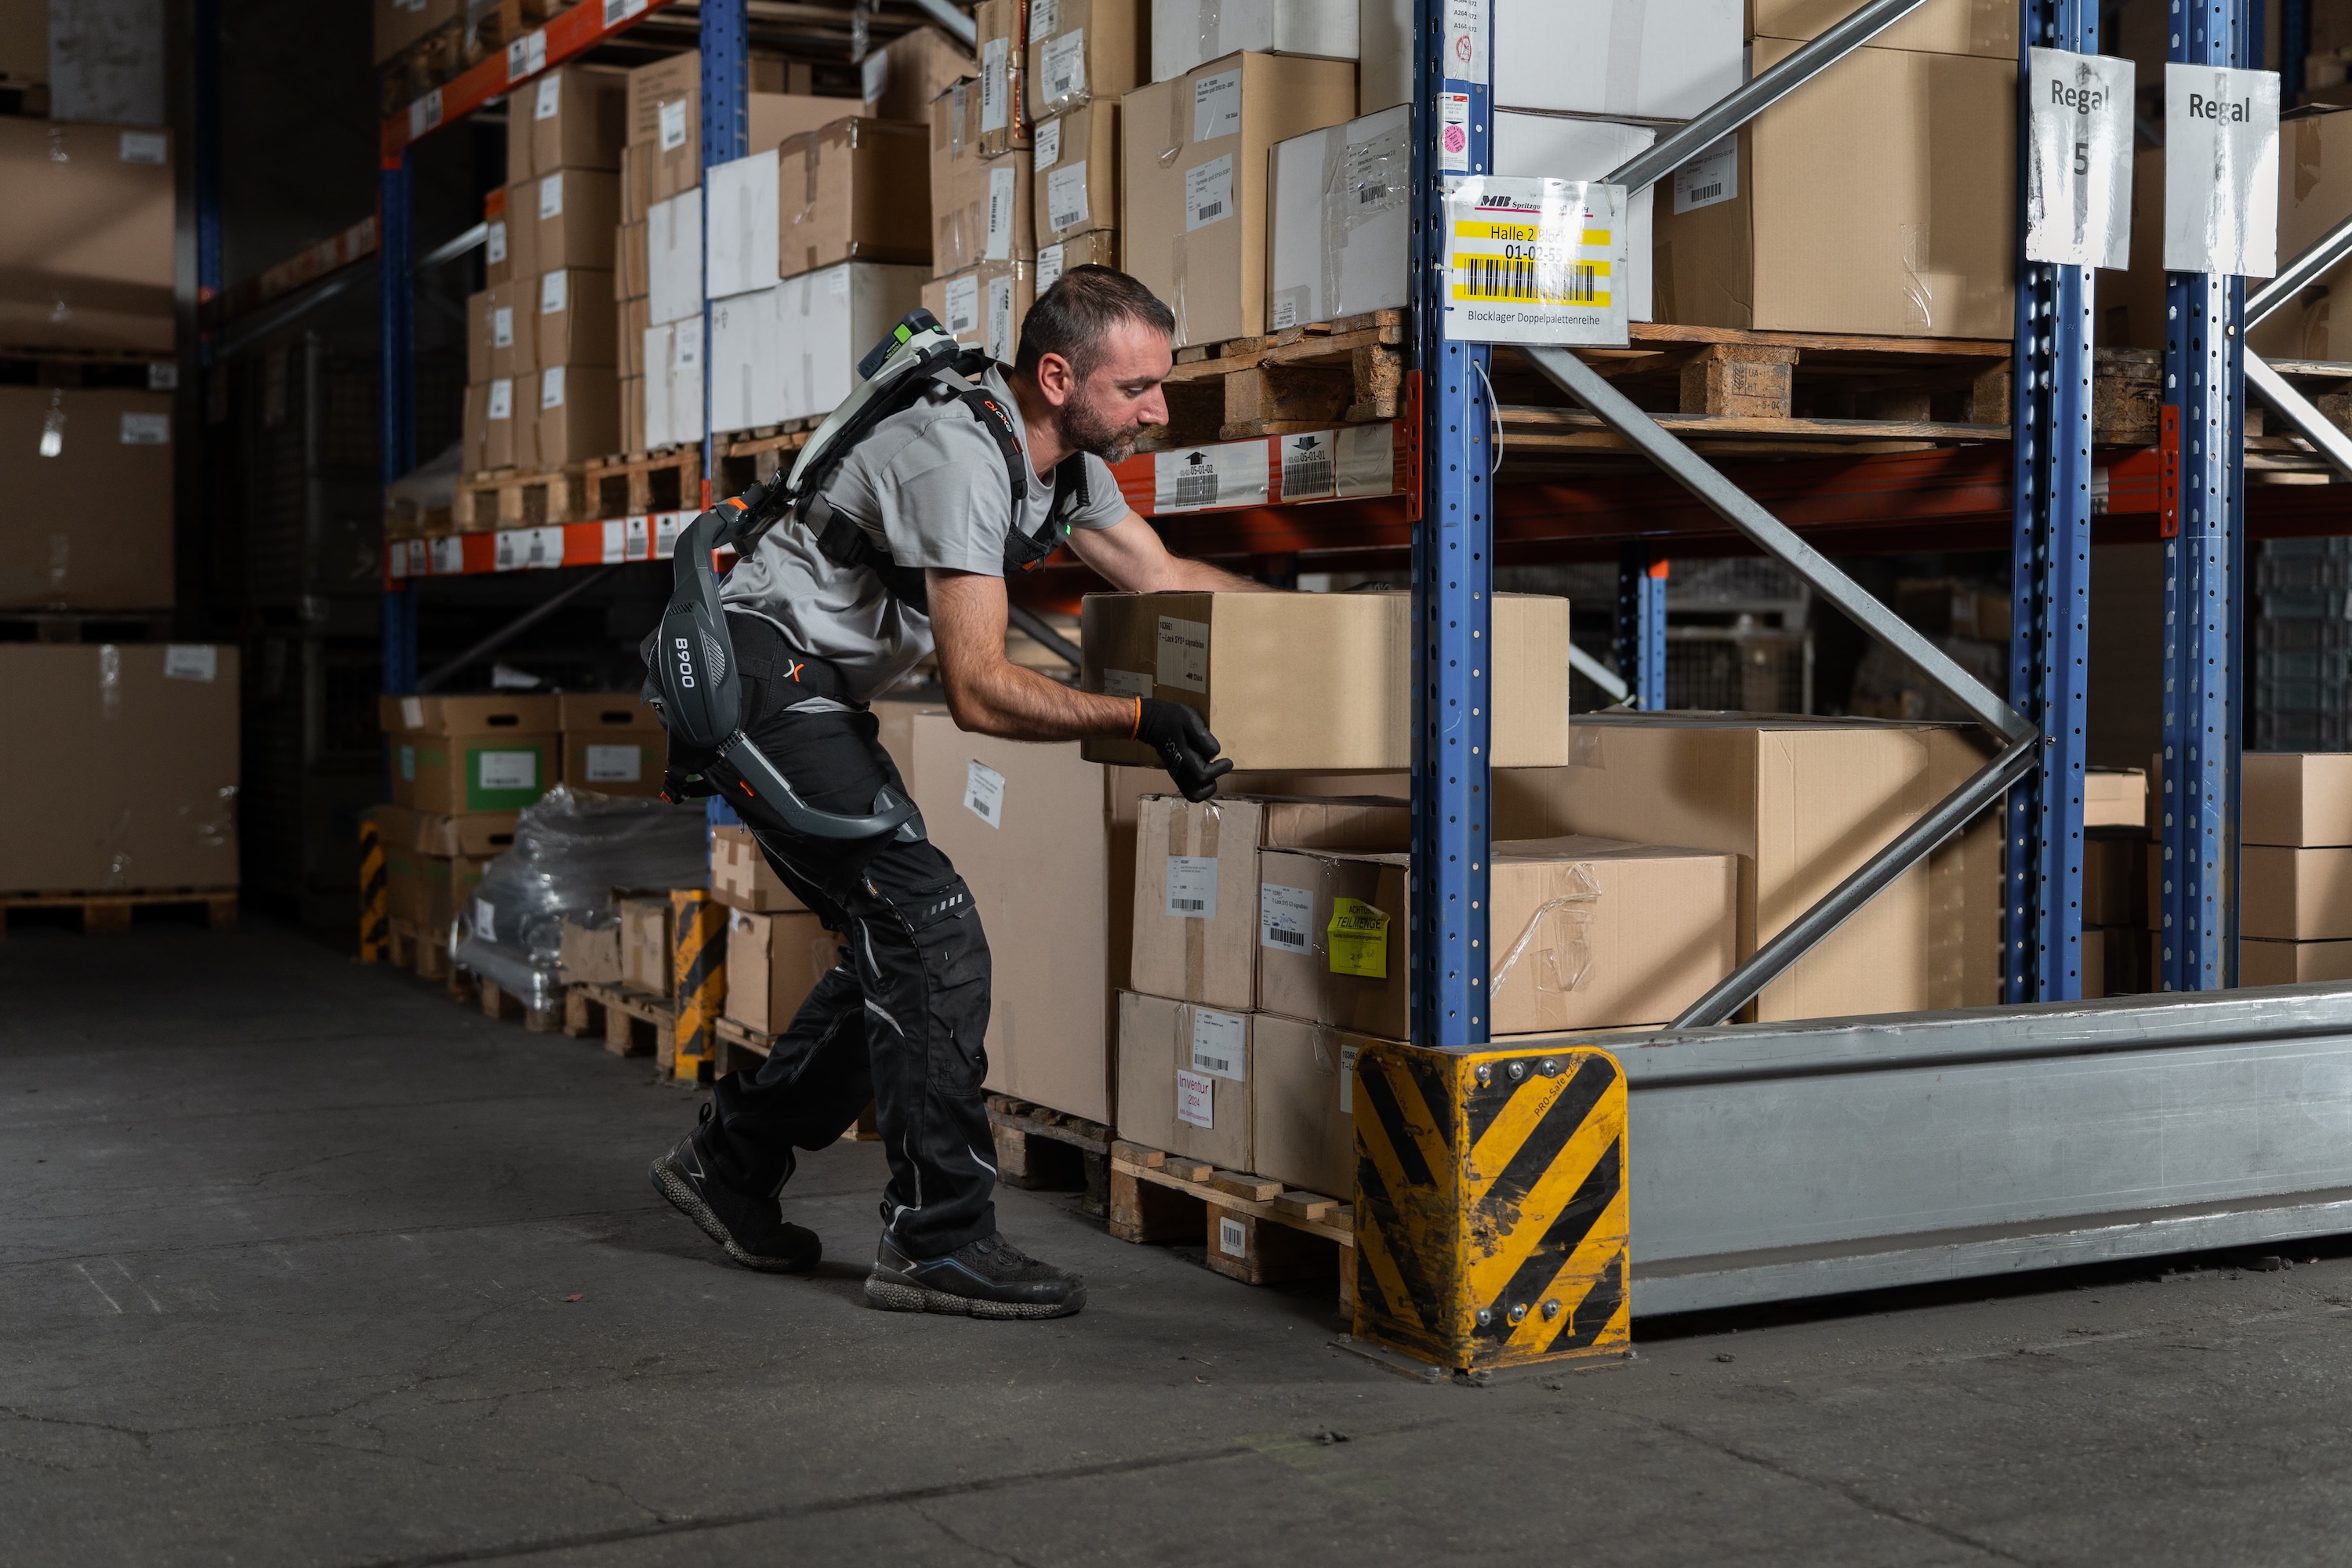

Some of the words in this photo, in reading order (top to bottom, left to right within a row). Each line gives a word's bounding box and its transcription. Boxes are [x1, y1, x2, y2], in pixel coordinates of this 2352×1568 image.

[2052, 79, 2109, 115] Regal
[2190, 94, 2250, 126] Regal
[2074, 143, 2089, 175] 5
[1491, 226, 1523, 241] Halle
[1527, 228, 1534, 241] 2
[1505, 244, 1563, 263] 01-02-55
[1468, 311, 1515, 323] Blocklager
[1517, 313, 1600, 325] Doppelpalettenreihe
[884, 343, 902, 360] FESTOOL
[675, 638, 695, 689] B900
[1349, 905, 1375, 915] ACHTUN
[1337, 917, 1382, 929] TEILMENGE
[1179, 1074, 1209, 1094] Inventur
[1534, 1078, 1566, 1117] PRO-Safe
